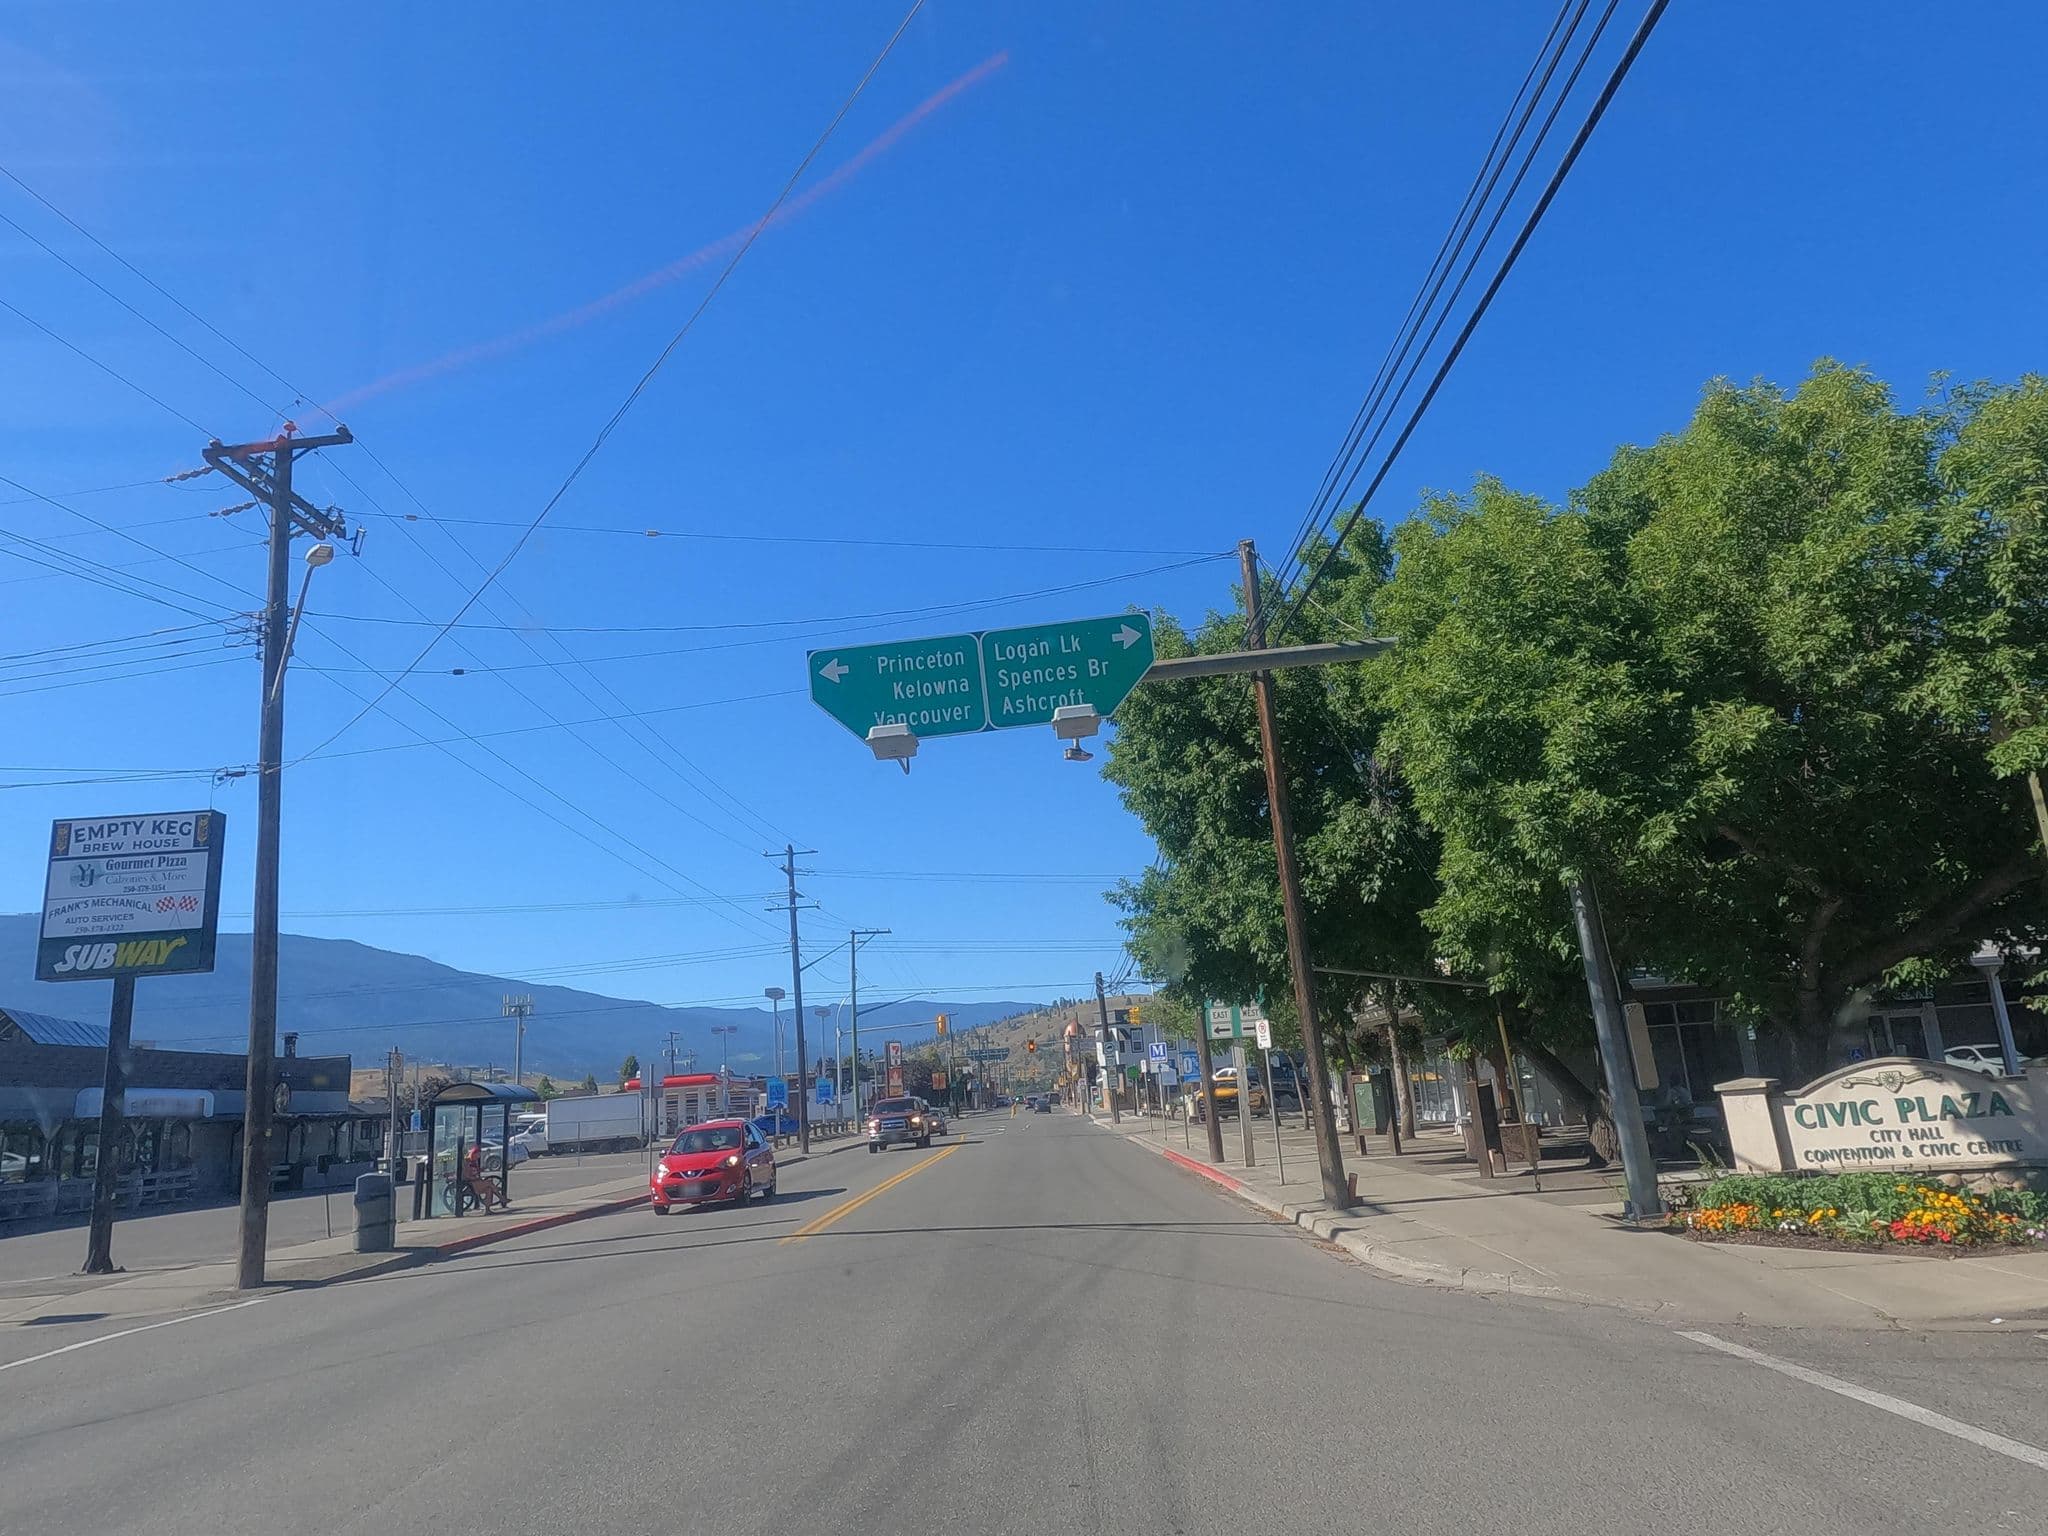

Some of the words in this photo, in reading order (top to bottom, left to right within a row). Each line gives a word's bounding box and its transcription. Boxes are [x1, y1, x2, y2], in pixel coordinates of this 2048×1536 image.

[994, 639, 1050, 664] Logan
[1060, 634, 1081, 655] Lk
[877, 651, 965, 675] Princeton
[998, 664, 1078, 692] Spences
[1088, 658, 1109, 678] Br
[893, 676, 970, 701] Kelowna
[1002, 688, 1085, 716] Ashcroft
[873, 703, 971, 727] Vancouver
[73, 819, 145, 844] EMPTY
[151, 819, 193, 836] KEG
[82, 841, 125, 853] BREW
[132, 837, 180, 850] HOUSE
[105, 858, 154, 872] Gourmet
[157, 855, 187, 868] Pizza
[162, 871, 188, 882] More
[48, 898, 89, 919] FRANK'S
[91, 897, 153, 913] MECHANICAL
[65, 915, 90, 925] AUTO
[91, 913, 135, 923] SERVICES
[53, 936, 188, 974] SUBWAY
[1212, 1010, 1229, 1020] EAST
[1794, 1099, 1884, 1130] CIVIC
[1894, 1090, 2015, 1124] PLAZA
[1869, 1129, 1903, 1143] CITY
[1909, 1127, 1944, 1141] HALL
[1804, 1146, 1896, 1164] CONVENTION
[1901, 1145, 1914, 1159] &
[1918, 1142, 1961, 1158] CIVIC
[1966, 1138, 2024, 1156] CENTRE
